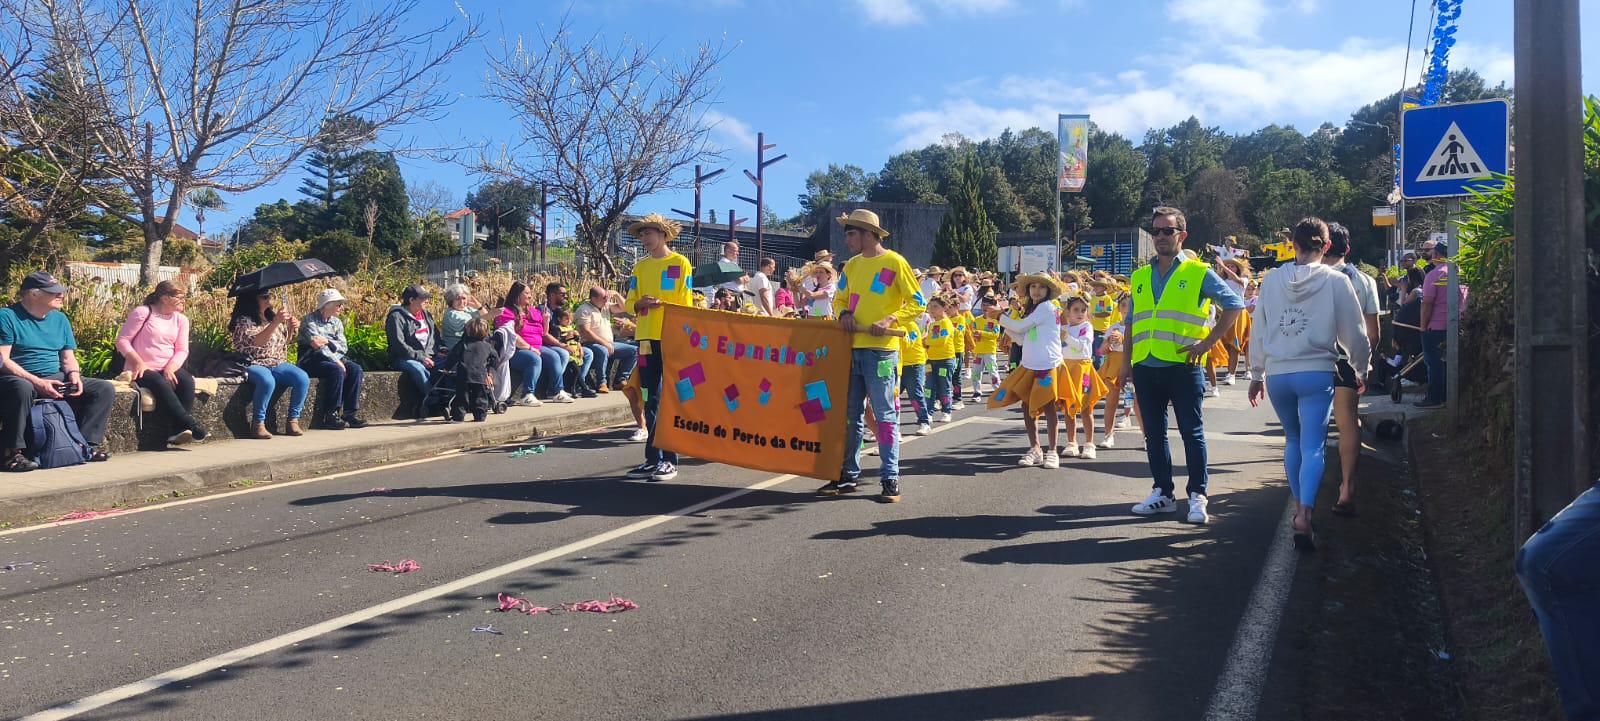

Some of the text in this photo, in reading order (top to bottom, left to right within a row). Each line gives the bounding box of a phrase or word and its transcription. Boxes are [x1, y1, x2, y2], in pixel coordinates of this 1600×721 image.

[673, 415, 710, 434] Escola
[732, 427, 767, 446] Porto
[770, 435, 786, 449] da
[790, 437, 822, 453] Cruz
